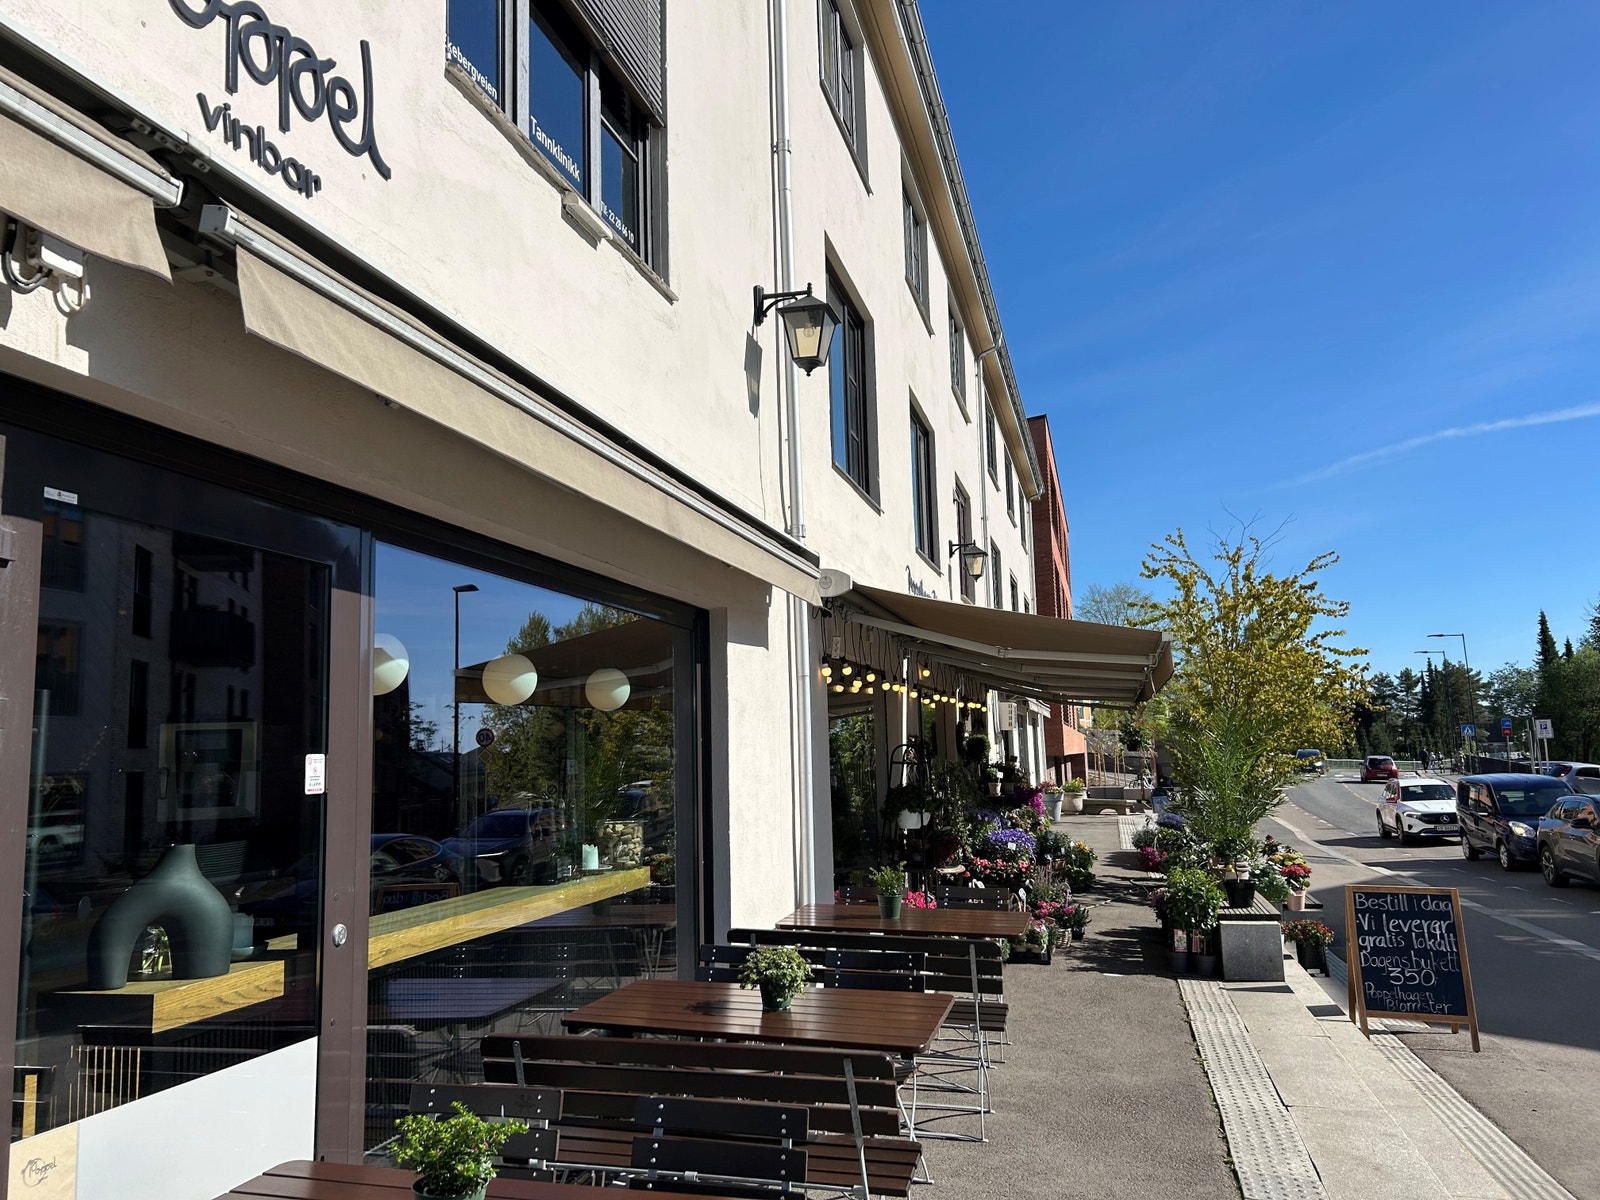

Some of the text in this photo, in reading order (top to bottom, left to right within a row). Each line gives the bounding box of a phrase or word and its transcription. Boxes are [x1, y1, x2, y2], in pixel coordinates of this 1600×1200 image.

[446, 41, 498, 100] kebergveien
[196, 92, 322, 199] vinbar
[530, 115, 581, 182] Tannklinikk
[1355, 893, 1454, 922] Bestill i dag
[1382, 913, 1450, 934] leverer
[1358, 931, 1458, 952] gratis lokalt
[1365, 981, 1435, 1004] Poppelhagen
[1387, 999, 1453, 1014] Blomster
